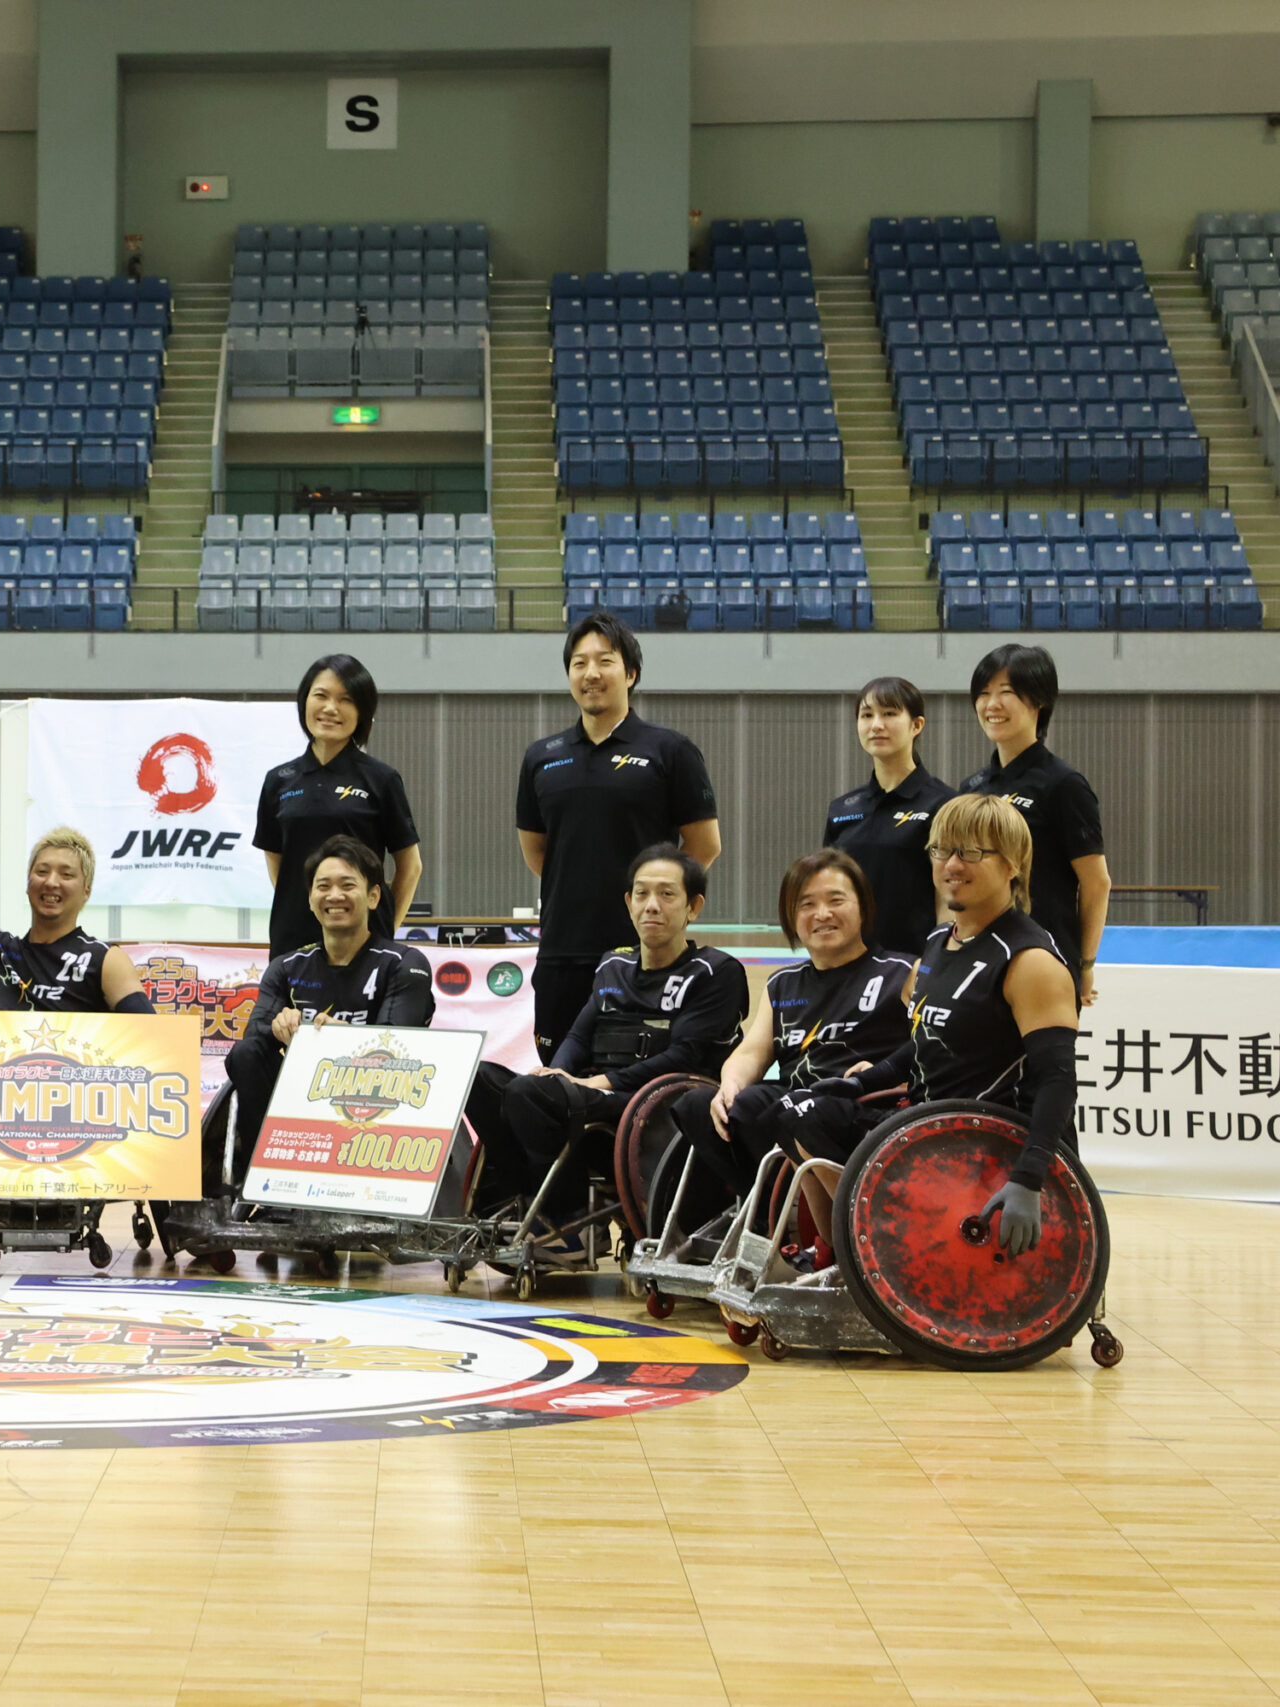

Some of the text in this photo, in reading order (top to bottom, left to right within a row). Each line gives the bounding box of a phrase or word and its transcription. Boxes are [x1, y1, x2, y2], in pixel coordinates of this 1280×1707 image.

[345, 94, 380, 132] S
[110, 828, 242, 859] JWRF
[111, 861, 233, 872] Japan Wheelchair Rugby Federation
[56, 952, 92, 982] 23
[362, 967, 379, 1000] 4
[952, 960, 988, 1000] 7
[661, 975, 695, 1012] 51
[858, 976, 884, 1012] 9
[308, 1058, 436, 1109] CHAMPIONS
[46, 1131, 124, 1140] CHAMPIONSHIPS
[1078, 1105, 1171, 1138] ITSUI
[336, 1132, 443, 1173] ¥100,000
[22, 1181, 34, 1191] in
[40, 1181, 153, 1195] 千葉ポートアリーナ
